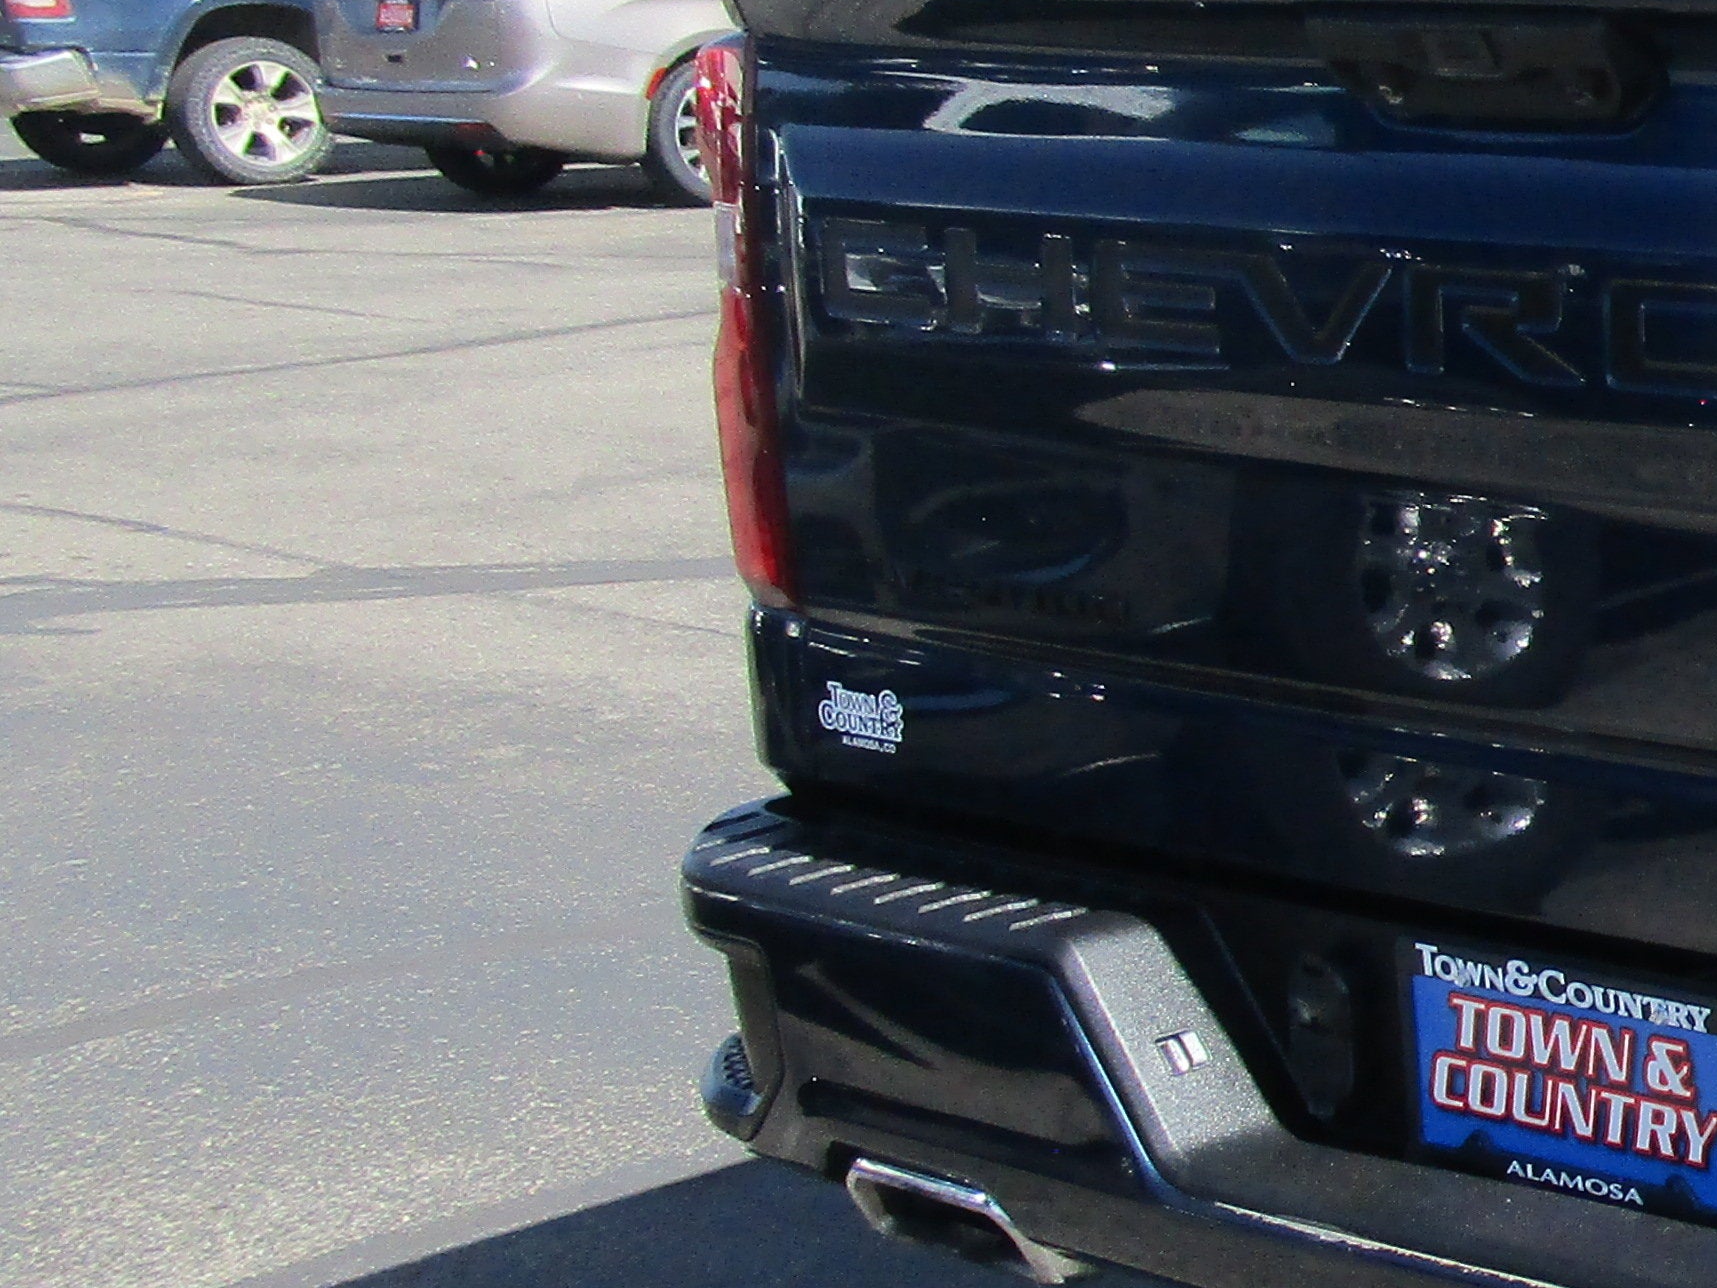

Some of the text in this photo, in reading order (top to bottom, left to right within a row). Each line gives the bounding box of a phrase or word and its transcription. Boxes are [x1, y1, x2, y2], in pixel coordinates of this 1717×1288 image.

[1448, 991, 1695, 1100] TOWN &
[1506, 1160, 1644, 1206] ALAMOSA
